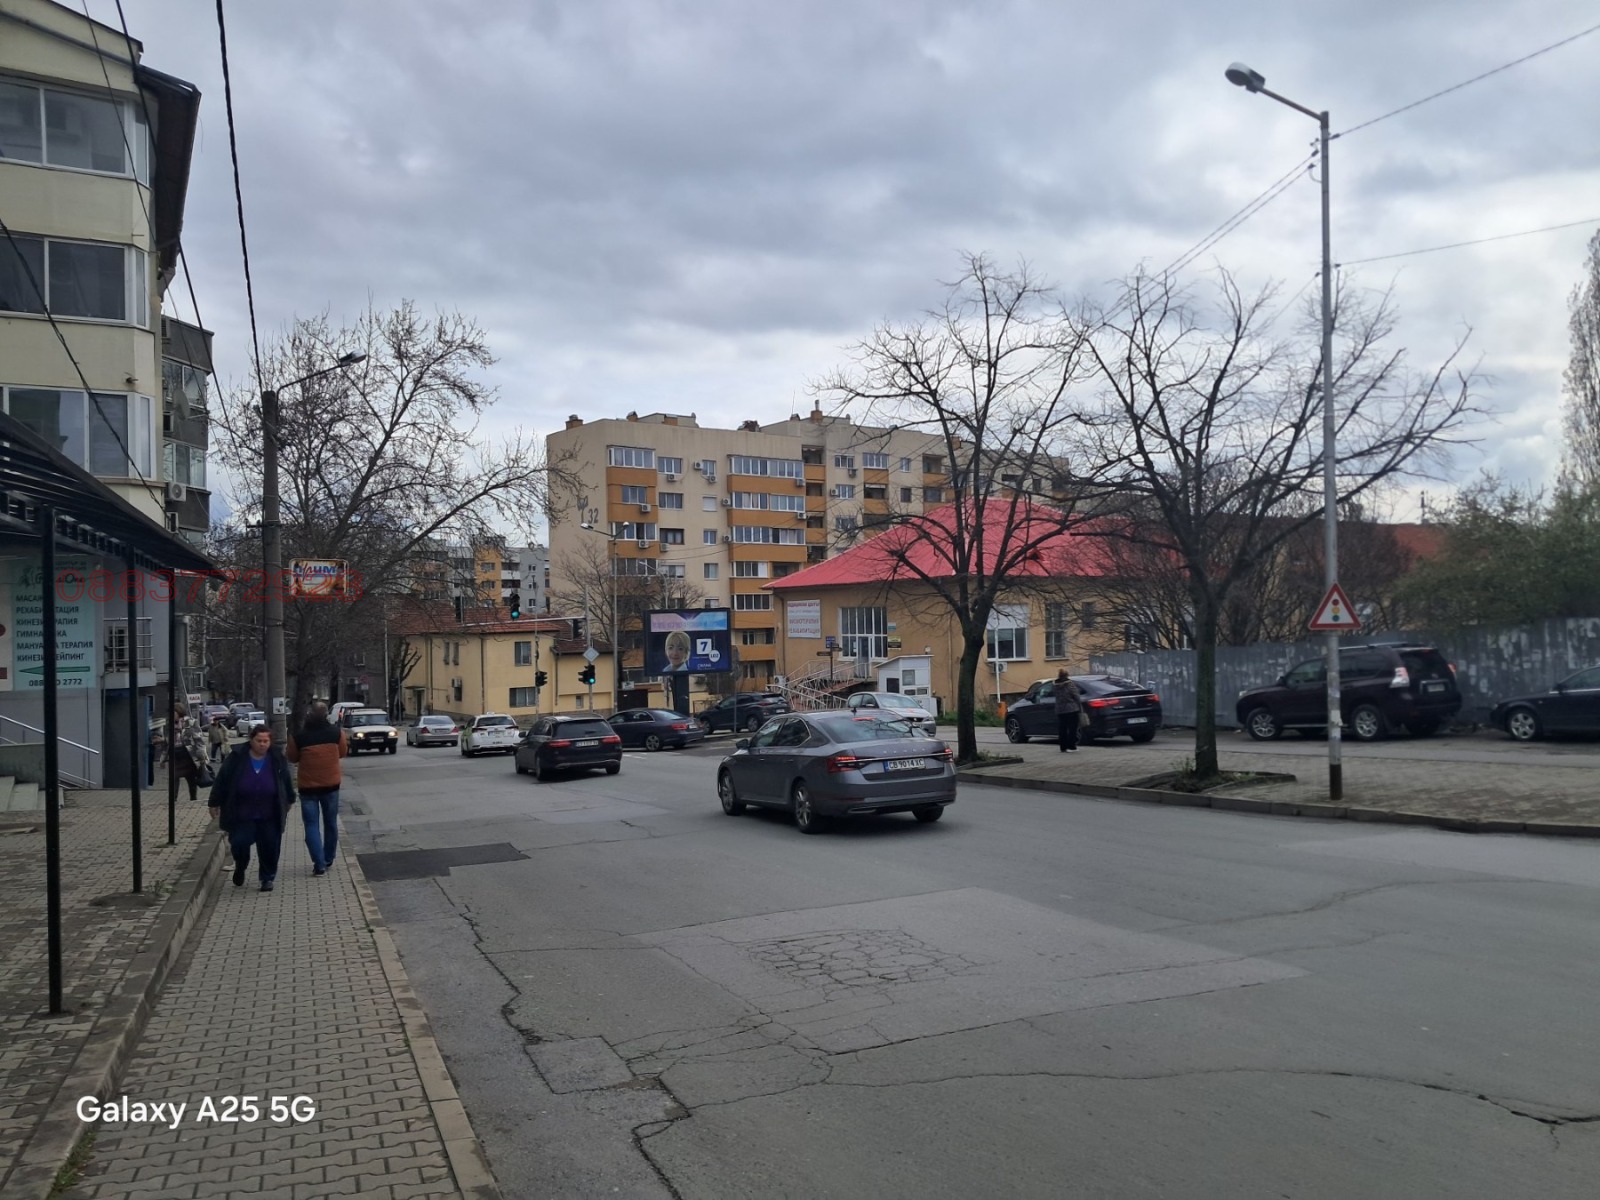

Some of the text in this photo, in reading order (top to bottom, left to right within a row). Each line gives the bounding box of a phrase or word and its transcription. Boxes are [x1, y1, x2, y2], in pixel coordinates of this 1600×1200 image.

[588, 508, 599, 524] 32
[700, 641, 708, 652] 7
[63, 678, 82, 686] 2772
